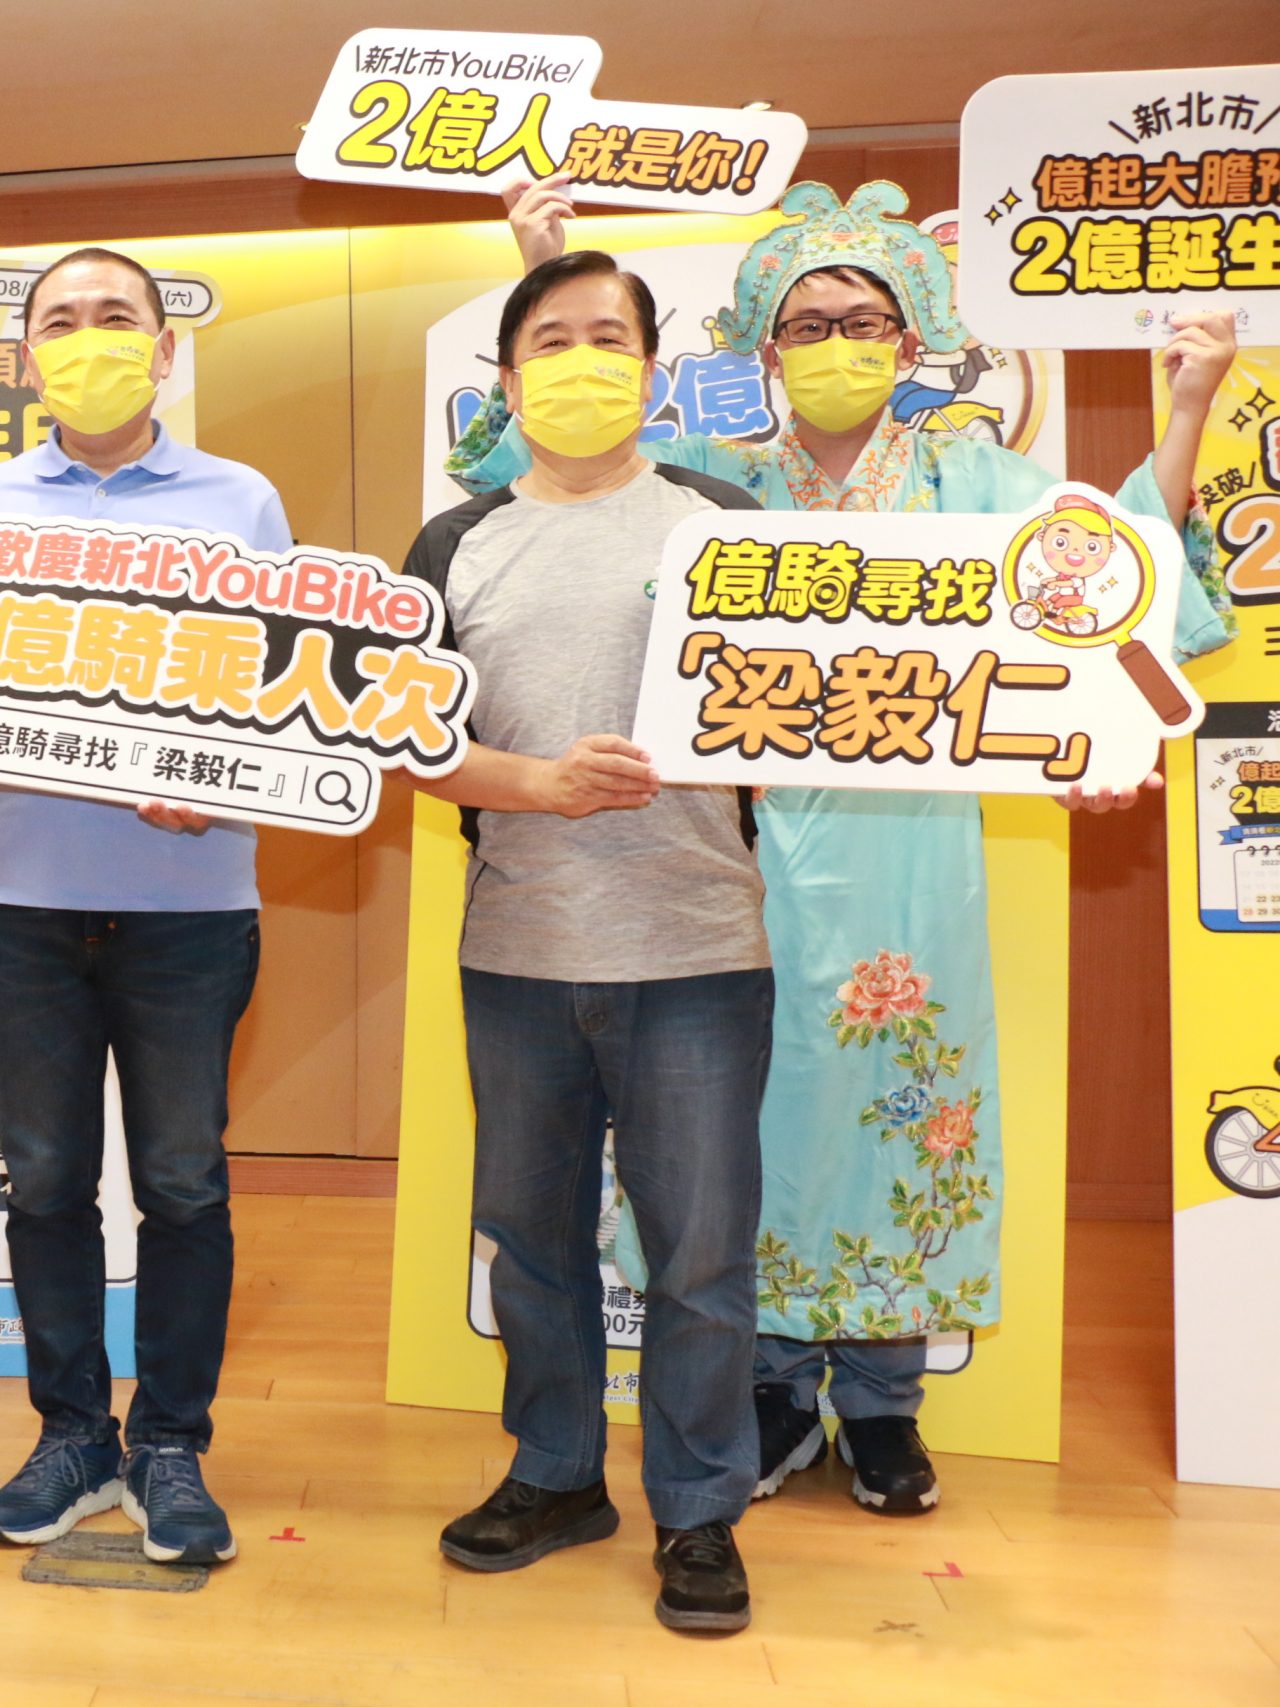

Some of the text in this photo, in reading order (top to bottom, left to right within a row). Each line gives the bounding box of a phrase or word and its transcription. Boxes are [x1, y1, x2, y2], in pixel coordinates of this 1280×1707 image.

[362, 44, 573, 84] 新北市YouBike
[1133, 91, 1260, 139] 新北市
[1011, 215, 1280, 296] 2億誕生
[687, 539, 994, 627] 億騎尋找
